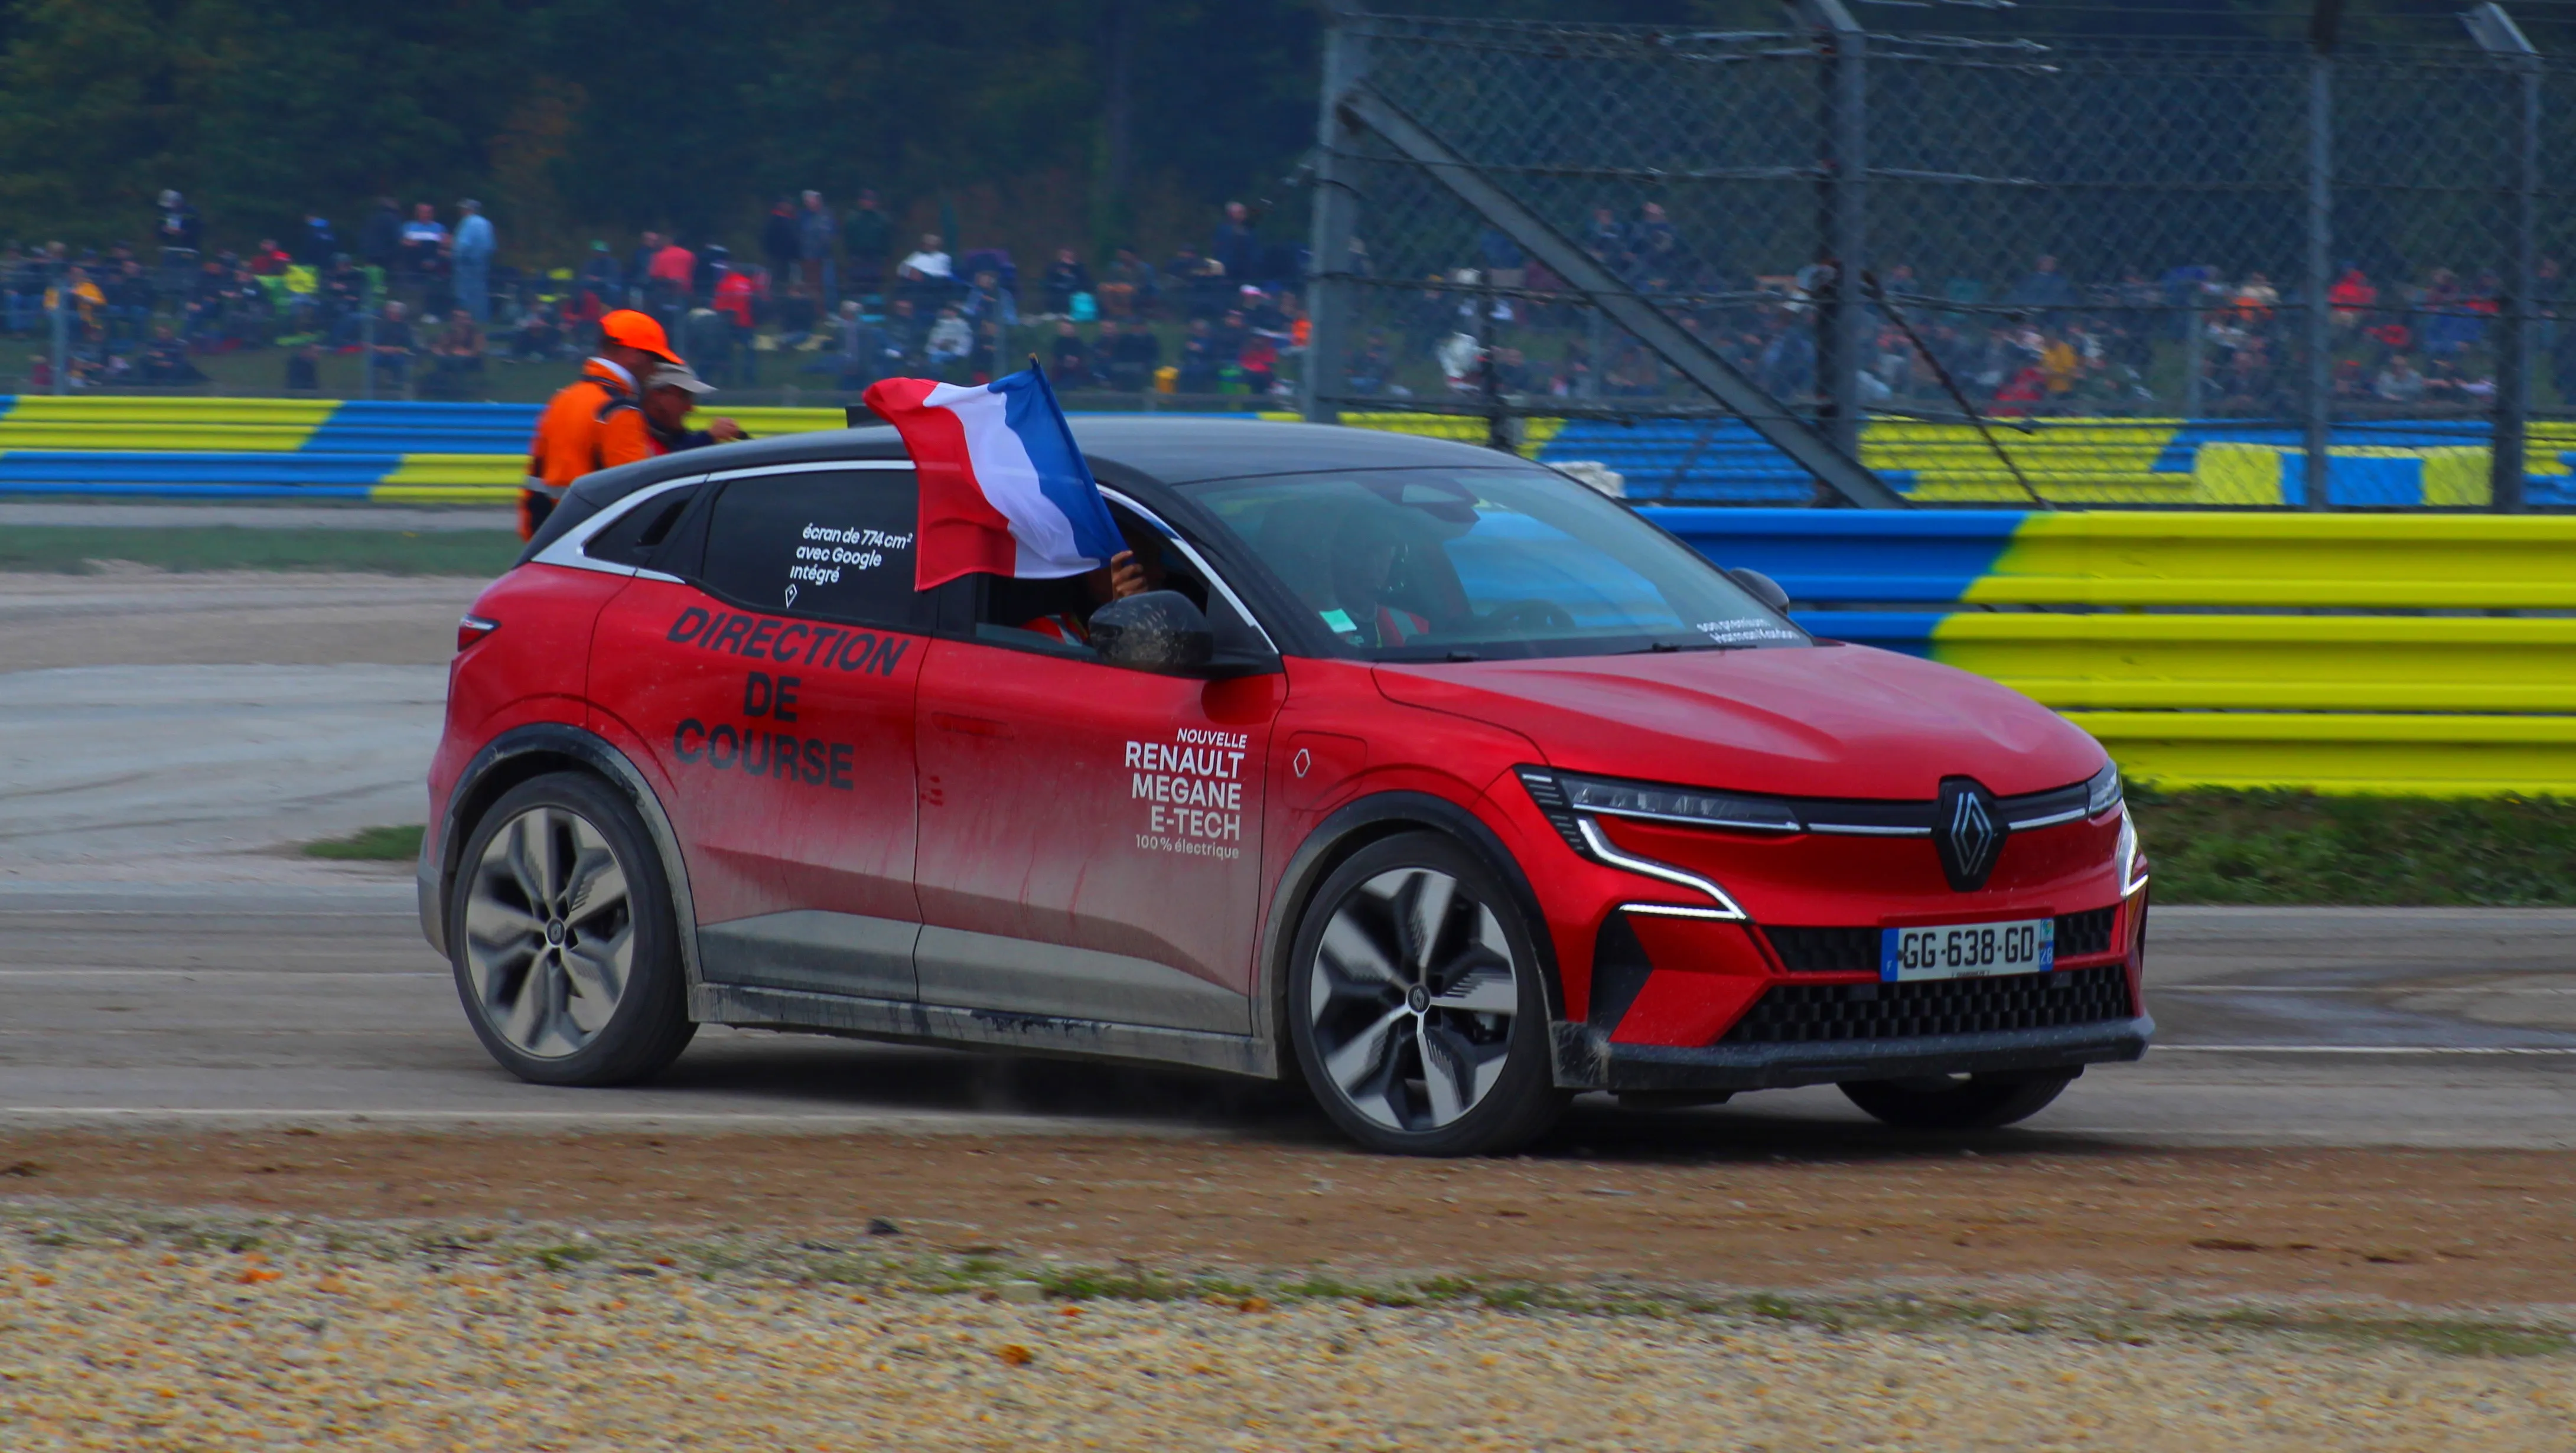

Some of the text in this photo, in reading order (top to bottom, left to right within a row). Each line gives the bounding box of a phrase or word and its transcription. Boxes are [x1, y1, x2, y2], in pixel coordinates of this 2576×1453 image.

[802, 523, 842, 542] écran
[842, 527, 860, 544] de
[861, 529, 884, 546] 774
[790, 563, 841, 585] intégré
[796, 546, 882, 569] avec Google
[666, 607, 911, 676] DIRECTION
[743, 672, 802, 723] DE
[673, 718, 855, 791] COURSE
[1177, 728, 1248, 749] NOUVELLE
[1125, 741, 1245, 779] RENAULT
[1132, 773, 1242, 811] MEGANE
[1151, 806, 1240, 840] E-TECH
[1174, 838, 1239, 860] électrique
